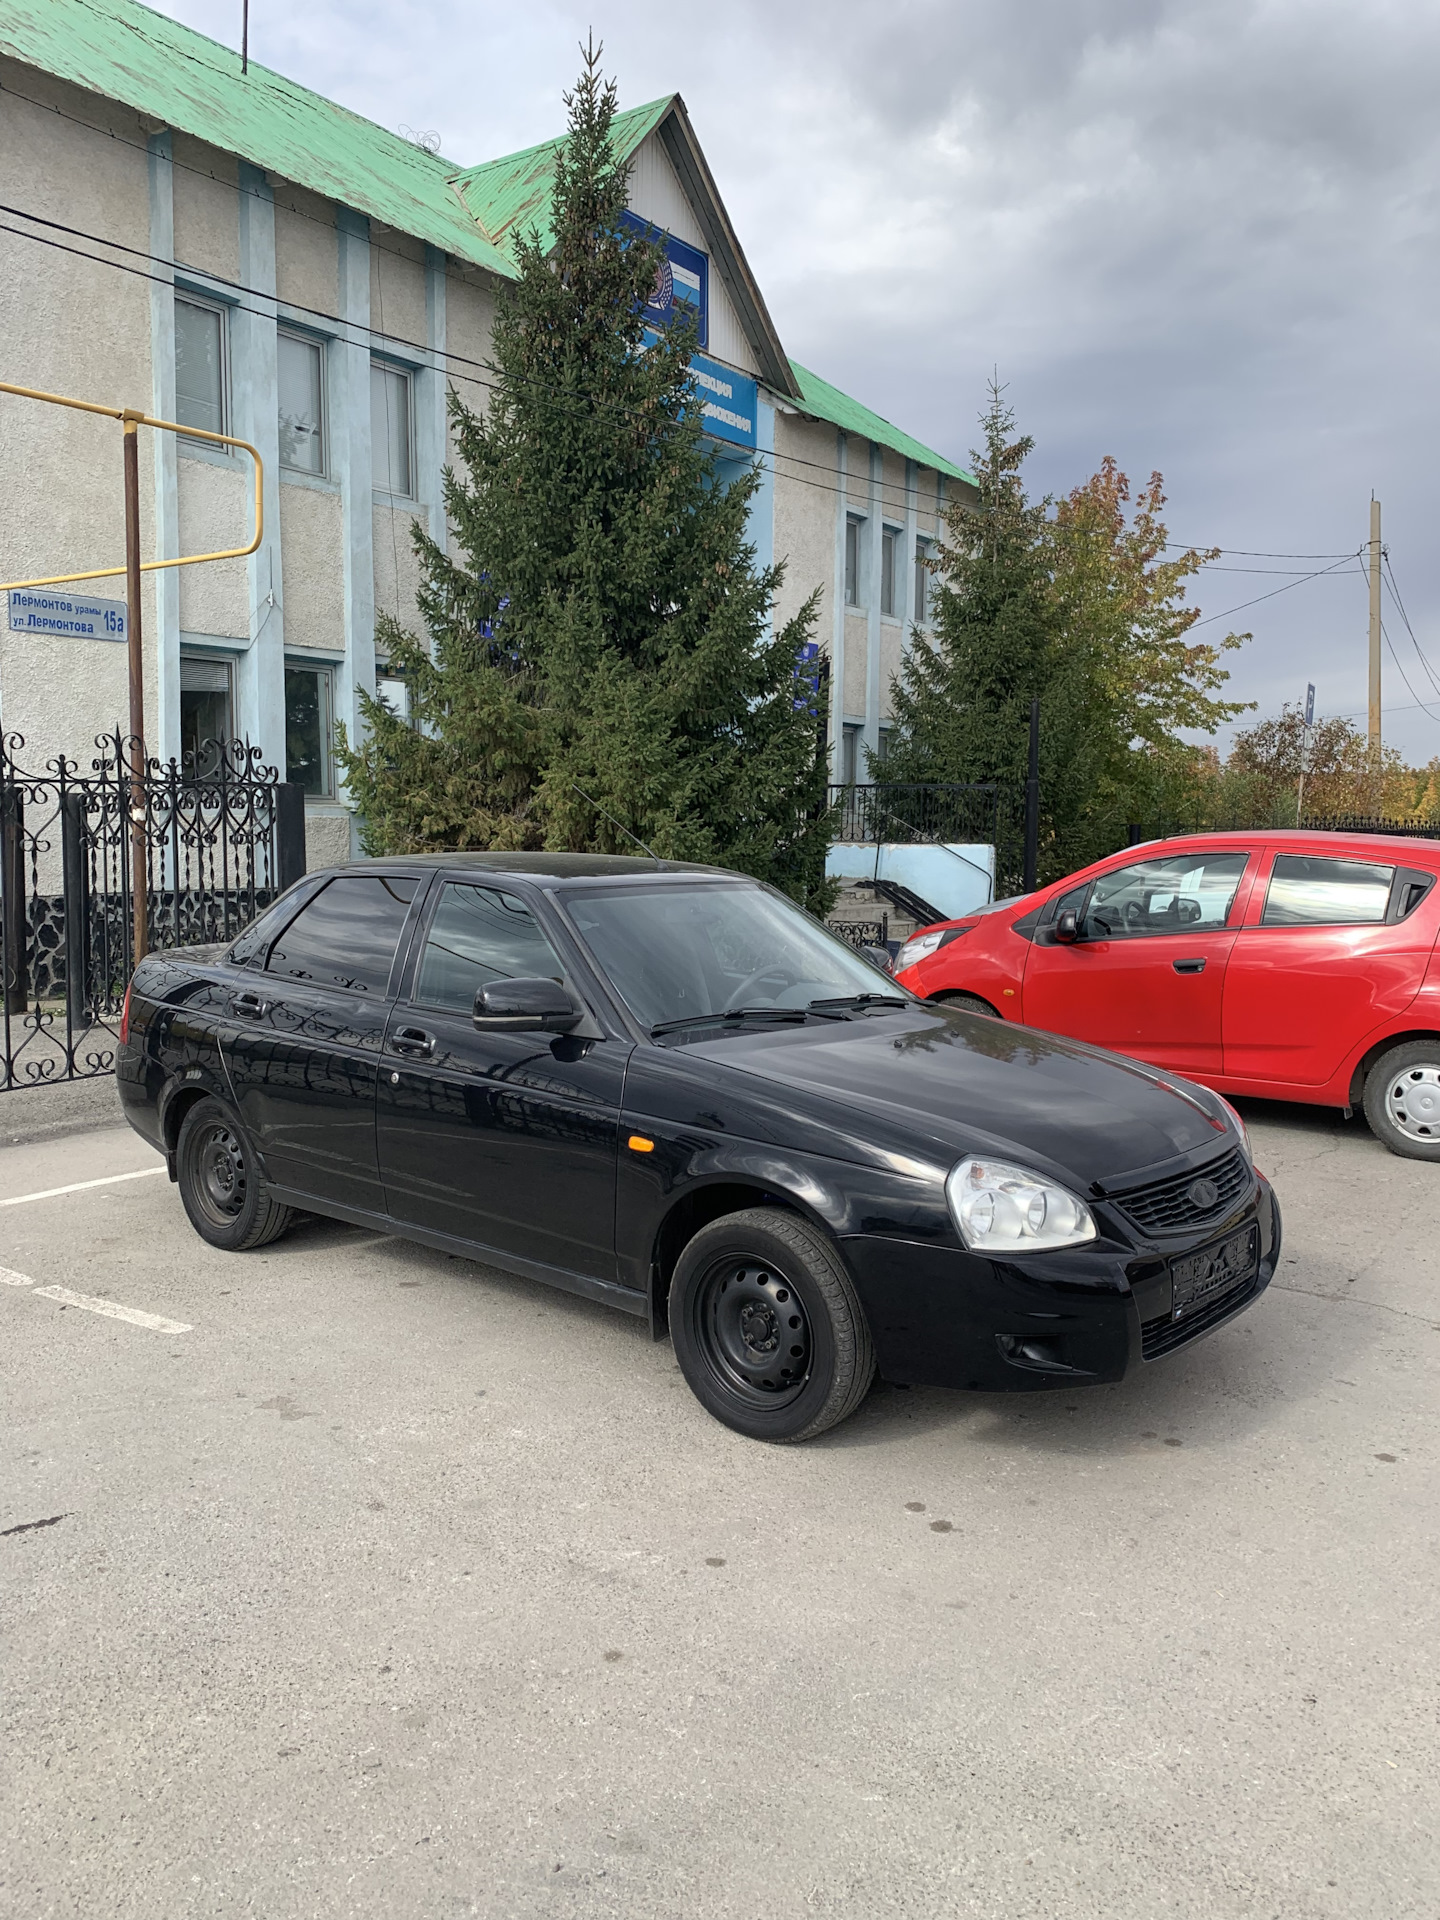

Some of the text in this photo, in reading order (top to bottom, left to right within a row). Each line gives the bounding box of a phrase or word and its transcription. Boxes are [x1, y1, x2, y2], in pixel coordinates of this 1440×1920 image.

[12, 592, 102, 616] Лермонтов урамы
[13, 614, 94, 633] ул. Лермонтова
[103, 610, 124, 633] 15а
